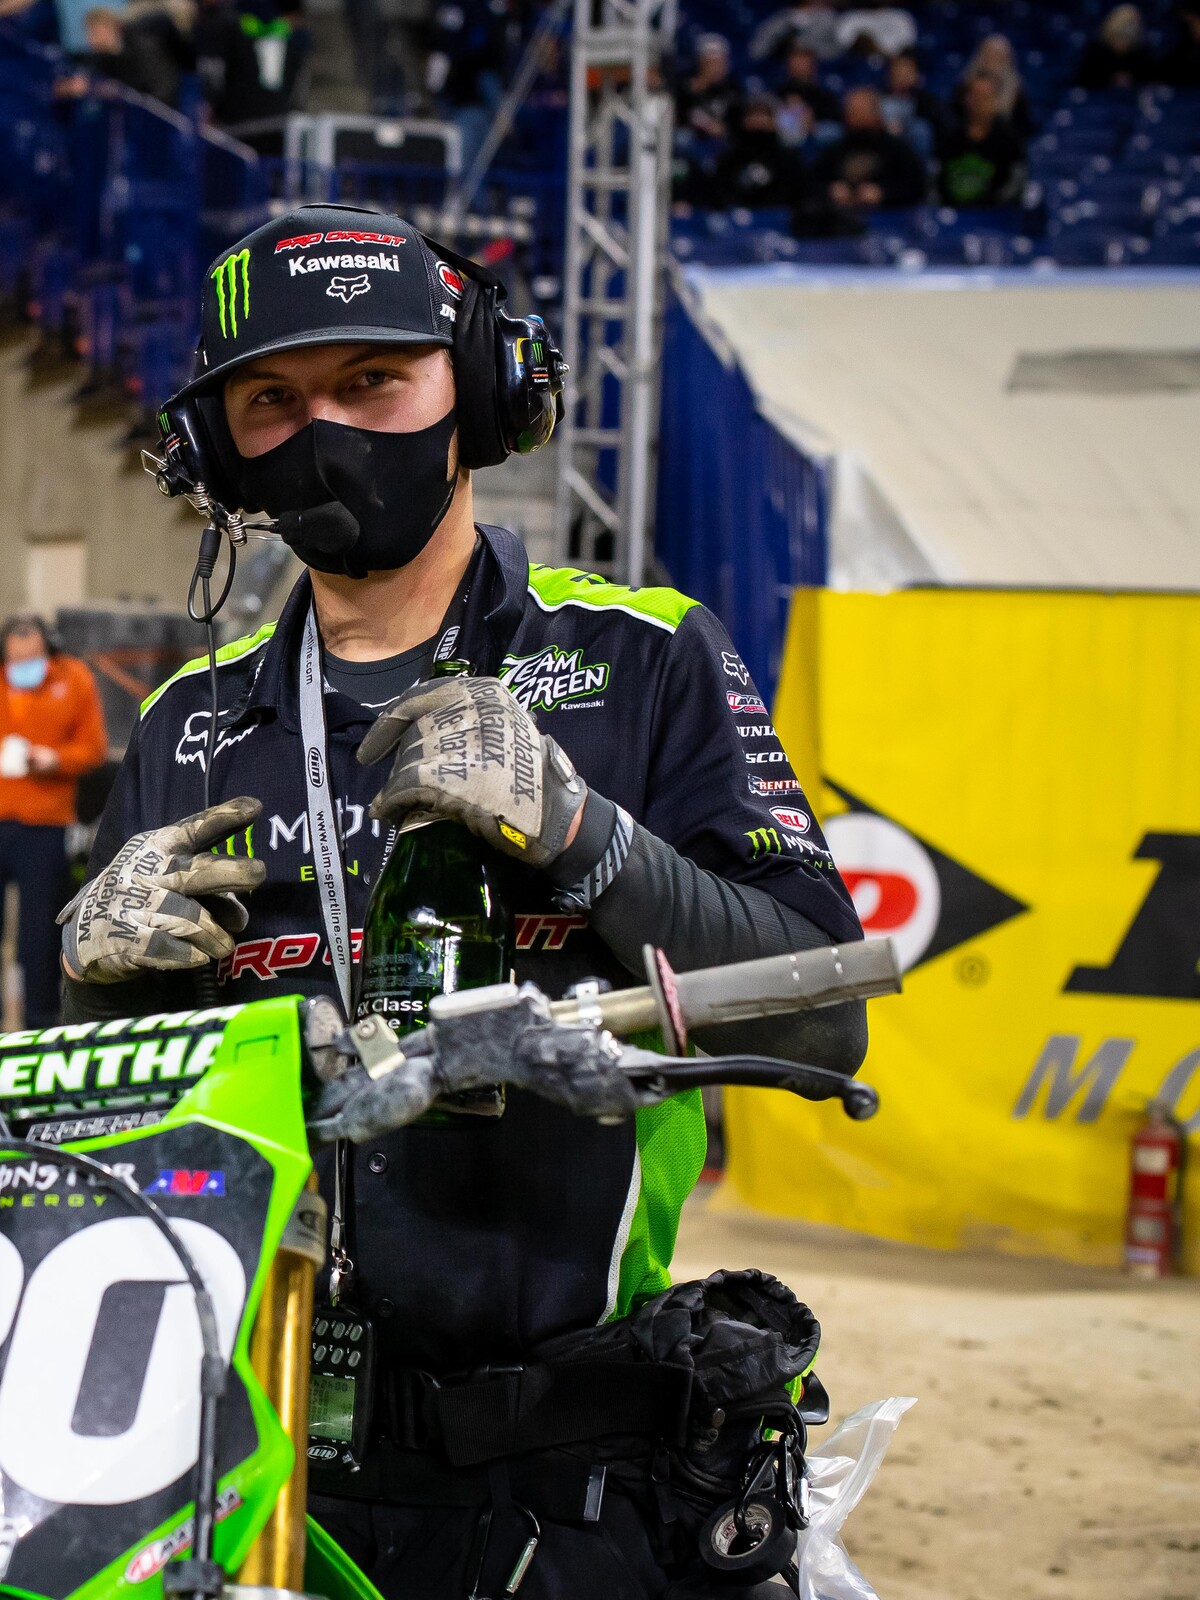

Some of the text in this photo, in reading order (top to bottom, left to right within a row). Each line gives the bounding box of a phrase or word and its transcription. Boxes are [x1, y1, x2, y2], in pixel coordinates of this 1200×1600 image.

[273, 229, 407, 255] PRO CIRCUIT
[288, 252, 400, 277] Kawasaki
[501, 647, 580, 687] TEAM
[509, 666, 606, 711] GREEN
[560, 699, 605, 711] Kawasaki
[758, 779, 802, 790] RENTH
[775, 813, 805, 829] BELL
[315, 810, 347, 967] www.aim-sportline.com
[372, 997, 424, 1013] Class
